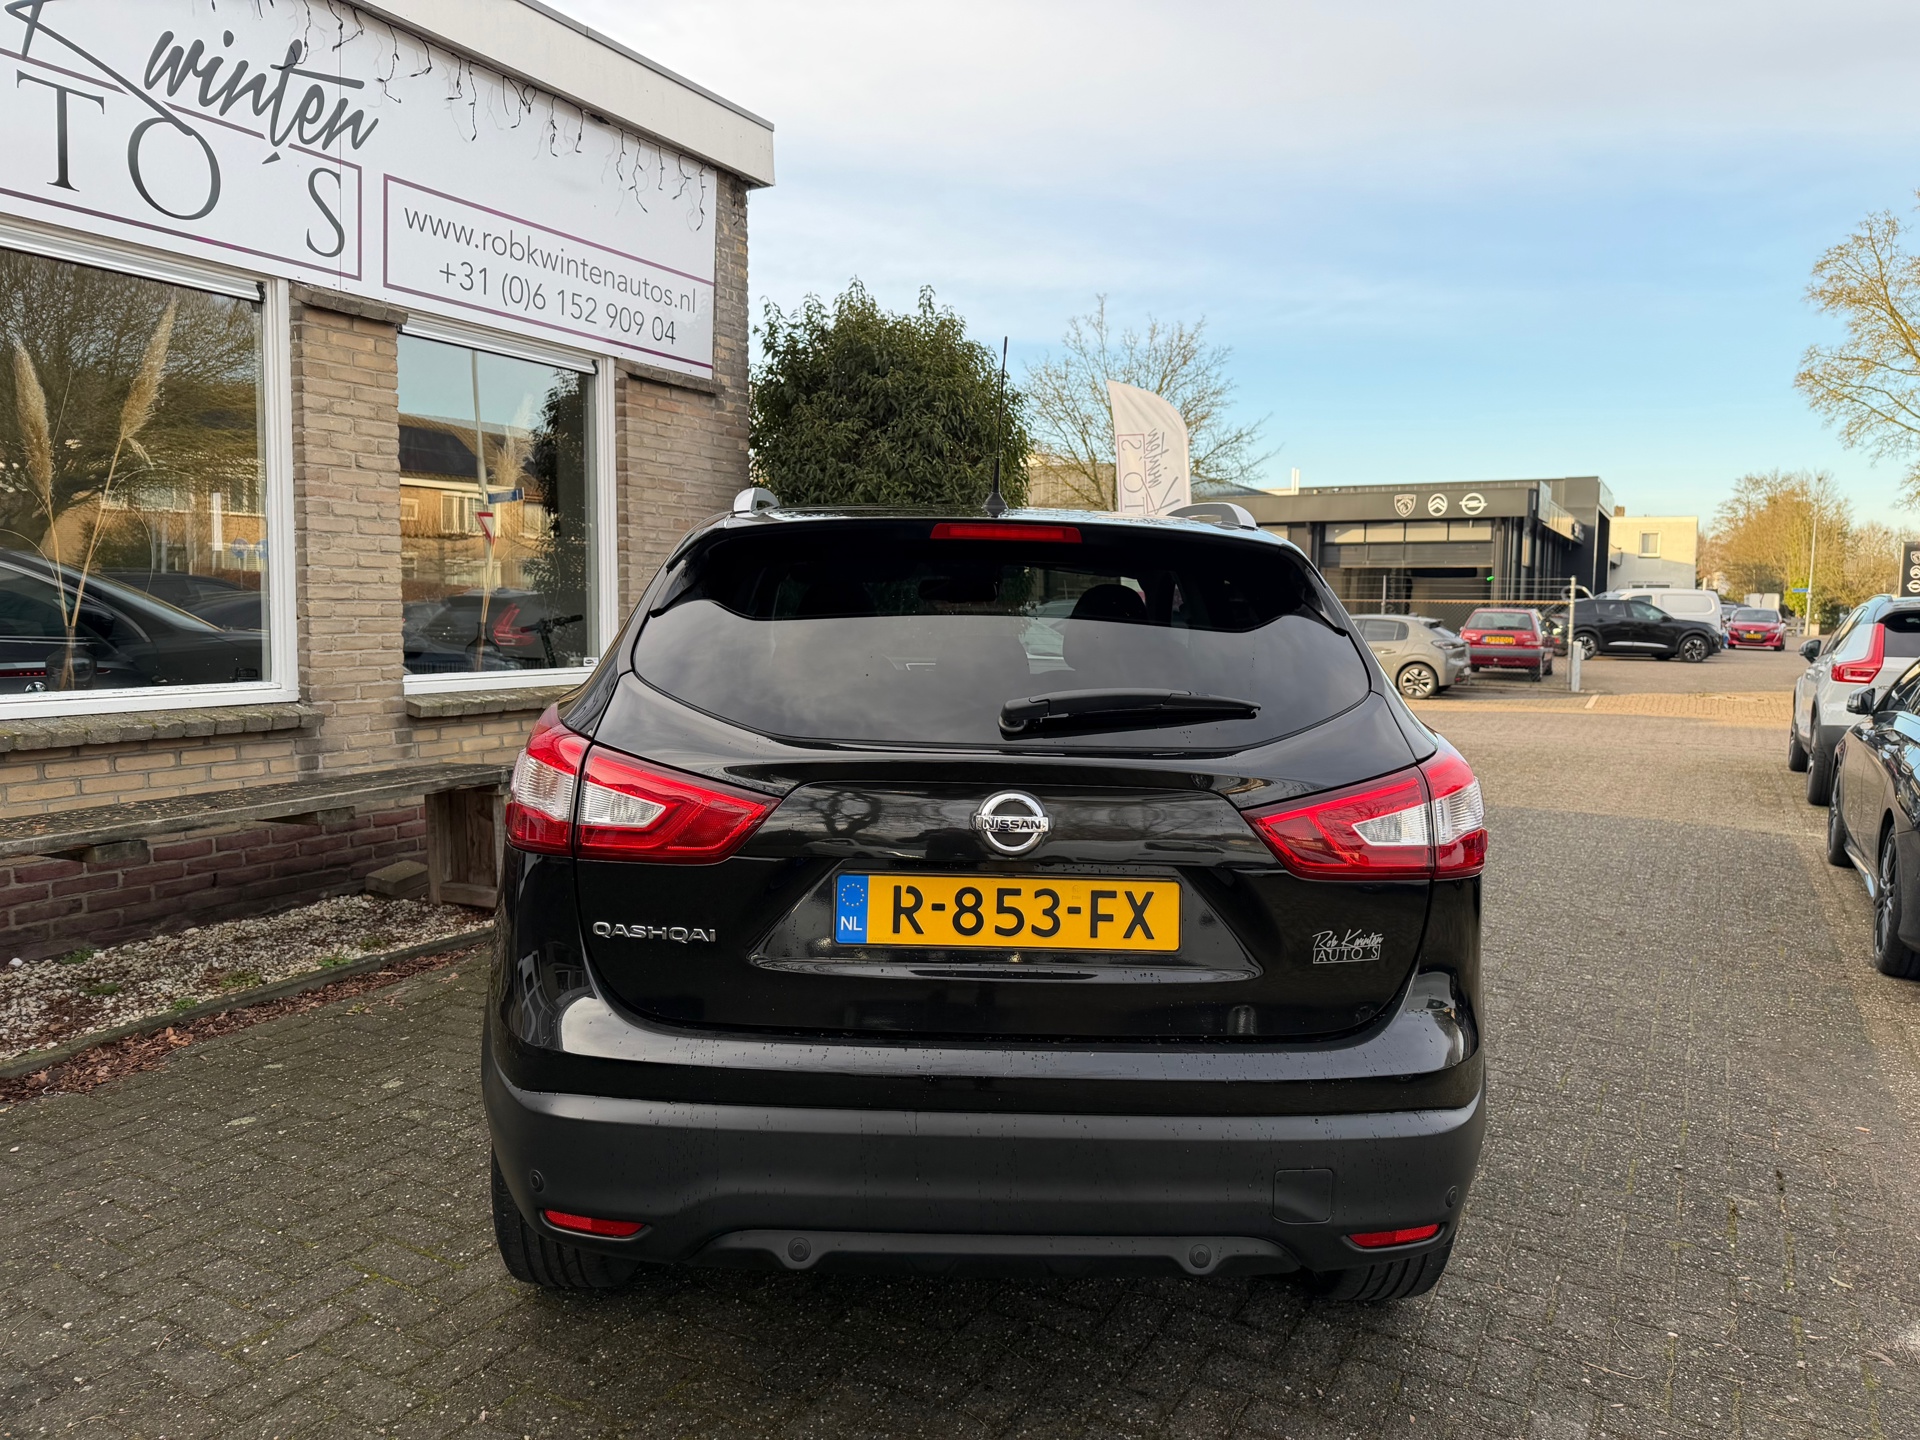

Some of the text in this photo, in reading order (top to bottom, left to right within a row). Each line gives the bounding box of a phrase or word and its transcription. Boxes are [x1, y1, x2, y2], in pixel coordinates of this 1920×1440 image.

[404, 206, 696, 314] www.robkwintenautos.nl
[439, 262, 676, 345] +31 (0)6 152 909 04
[983, 819, 1041, 830] NISSAN
[840, 915, 862, 931] NL
[892, 884, 1155, 940] R-853-FX
[592, 921, 717, 944] QASHQAI
